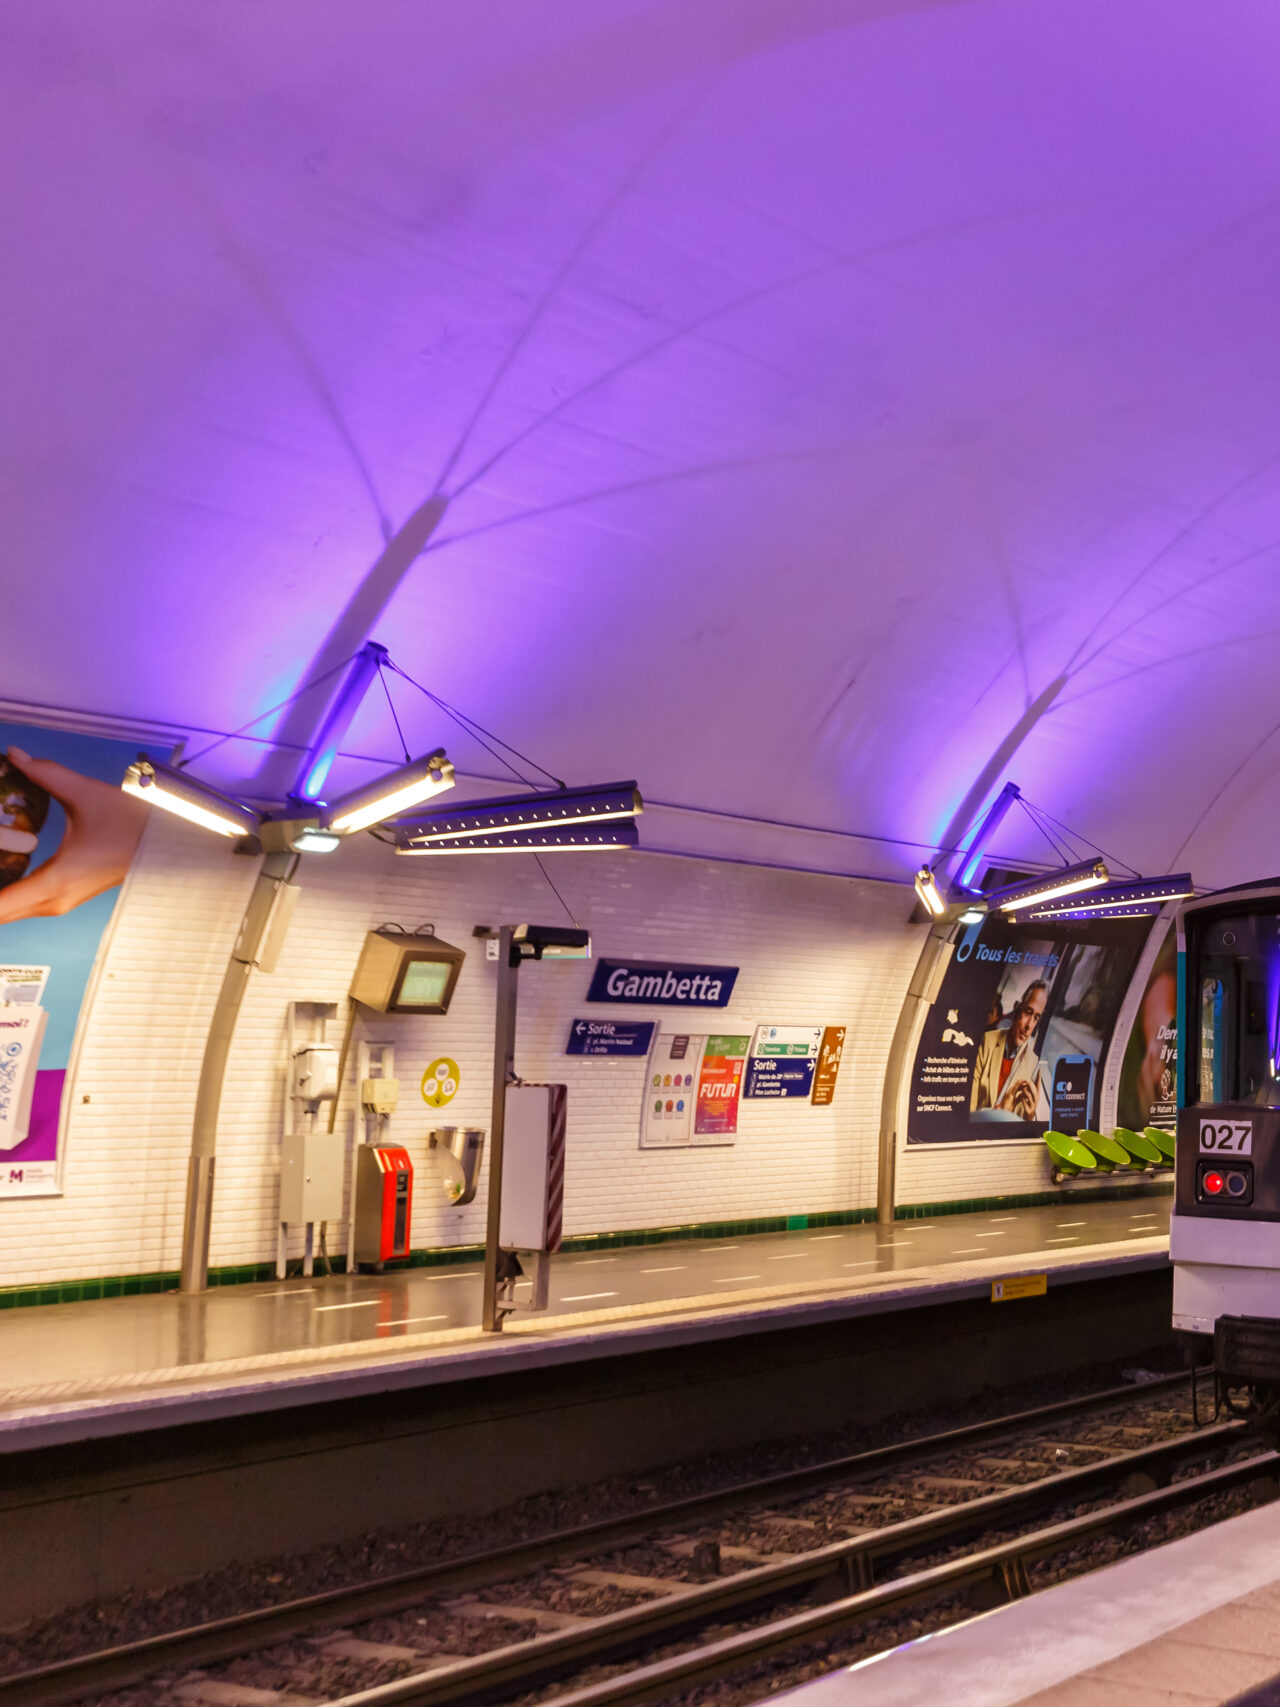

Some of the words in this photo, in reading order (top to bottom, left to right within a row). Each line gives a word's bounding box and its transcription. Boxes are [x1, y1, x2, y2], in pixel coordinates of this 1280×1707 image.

[975, 943, 1003, 962] Tous
[1003, 945, 1022, 963] les
[1023, 951, 1059, 970] trajets
[606, 968, 722, 1001] Gambetta
[587, 1022, 616, 1035] Sortie
[753, 1060, 777, 1071] Sortie
[1200, 1123, 1252, 1151] 027
